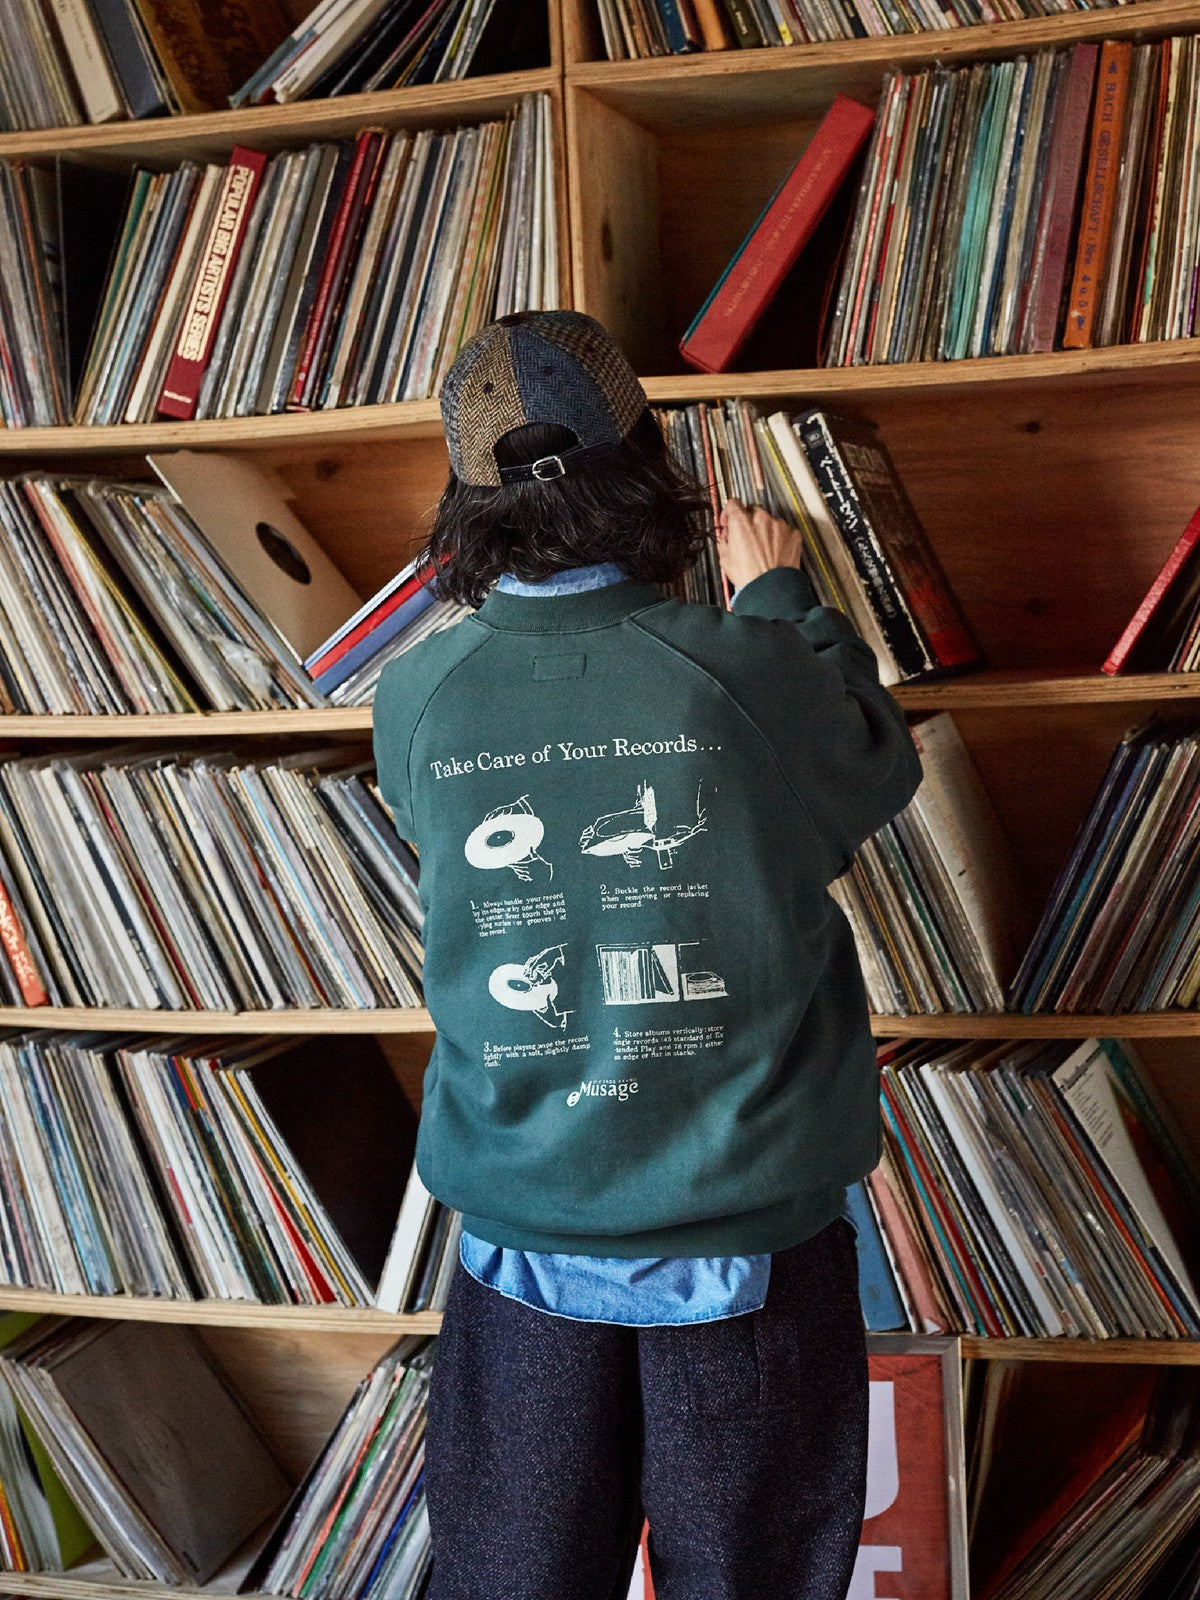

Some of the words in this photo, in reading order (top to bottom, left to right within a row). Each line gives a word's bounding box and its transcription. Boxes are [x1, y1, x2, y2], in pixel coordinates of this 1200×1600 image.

[218, 164, 249, 230] POPULAR
[211, 228, 232, 255] BIG
[195, 253, 224, 314] ARTISTS
[182, 311, 208, 361] SERIES
[431, 759, 474, 779] Take
[477, 752, 525, 771] Care
[532, 745, 551, 763] of
[558, 743, 606, 761] Your
[526, 896, 541, 904] your
[543, 892, 564, 900] record
[677, 890, 709, 898] replacing
[522, 911, 540, 919] touch
[602, 903, 617, 911] your
[493, 1045, 512, 1053] Before
[568, 1035, 588, 1044] record
[705, 1040, 723, 1048] either
[580, 1080, 639, 1101] Musage
